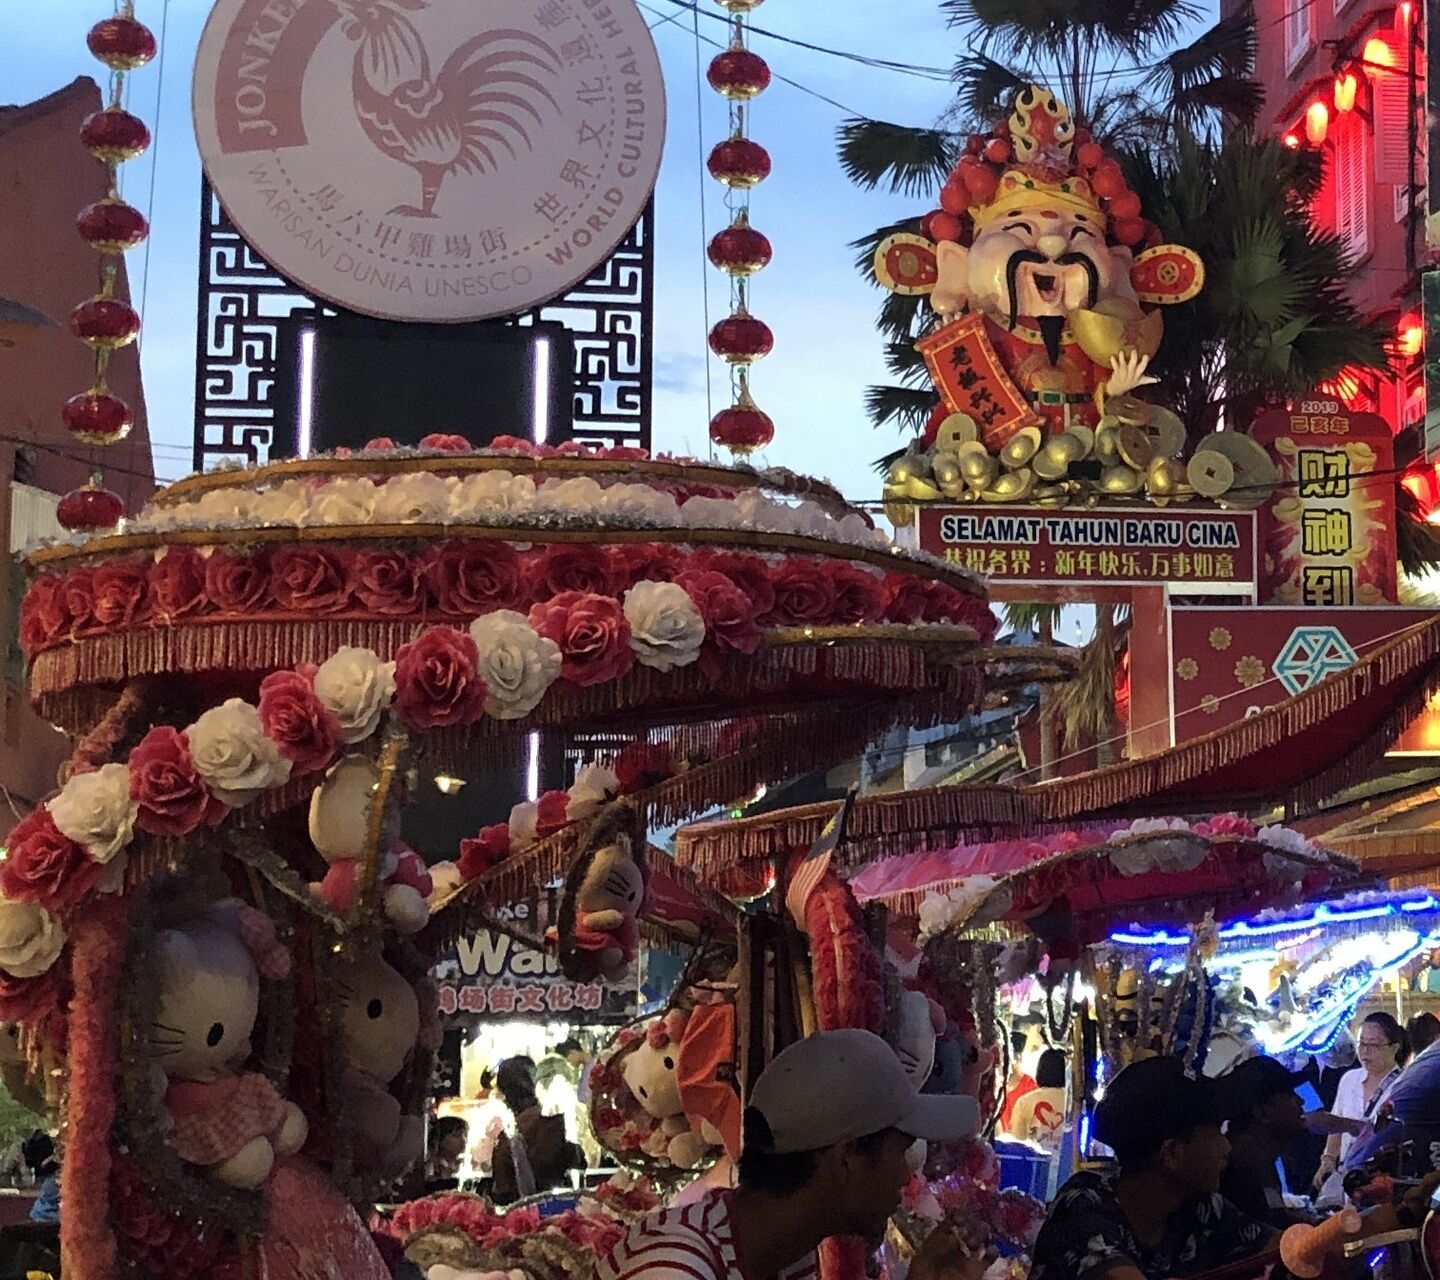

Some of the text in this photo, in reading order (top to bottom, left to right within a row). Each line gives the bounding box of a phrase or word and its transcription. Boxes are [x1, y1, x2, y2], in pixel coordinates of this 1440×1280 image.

[546, 186, 625, 267] WORLD
[616, 45, 646, 179] CULTURAL
[248, 162, 532, 297] WARISAN DUNIA UNESCO
[1290, 415, 1350, 436] 己亥年
[1301, 401, 1339, 415] 2019
[941, 515, 1239, 548] SELAMAT TAHUN BARU CINA
[1299, 449, 1353, 606] 财神到
